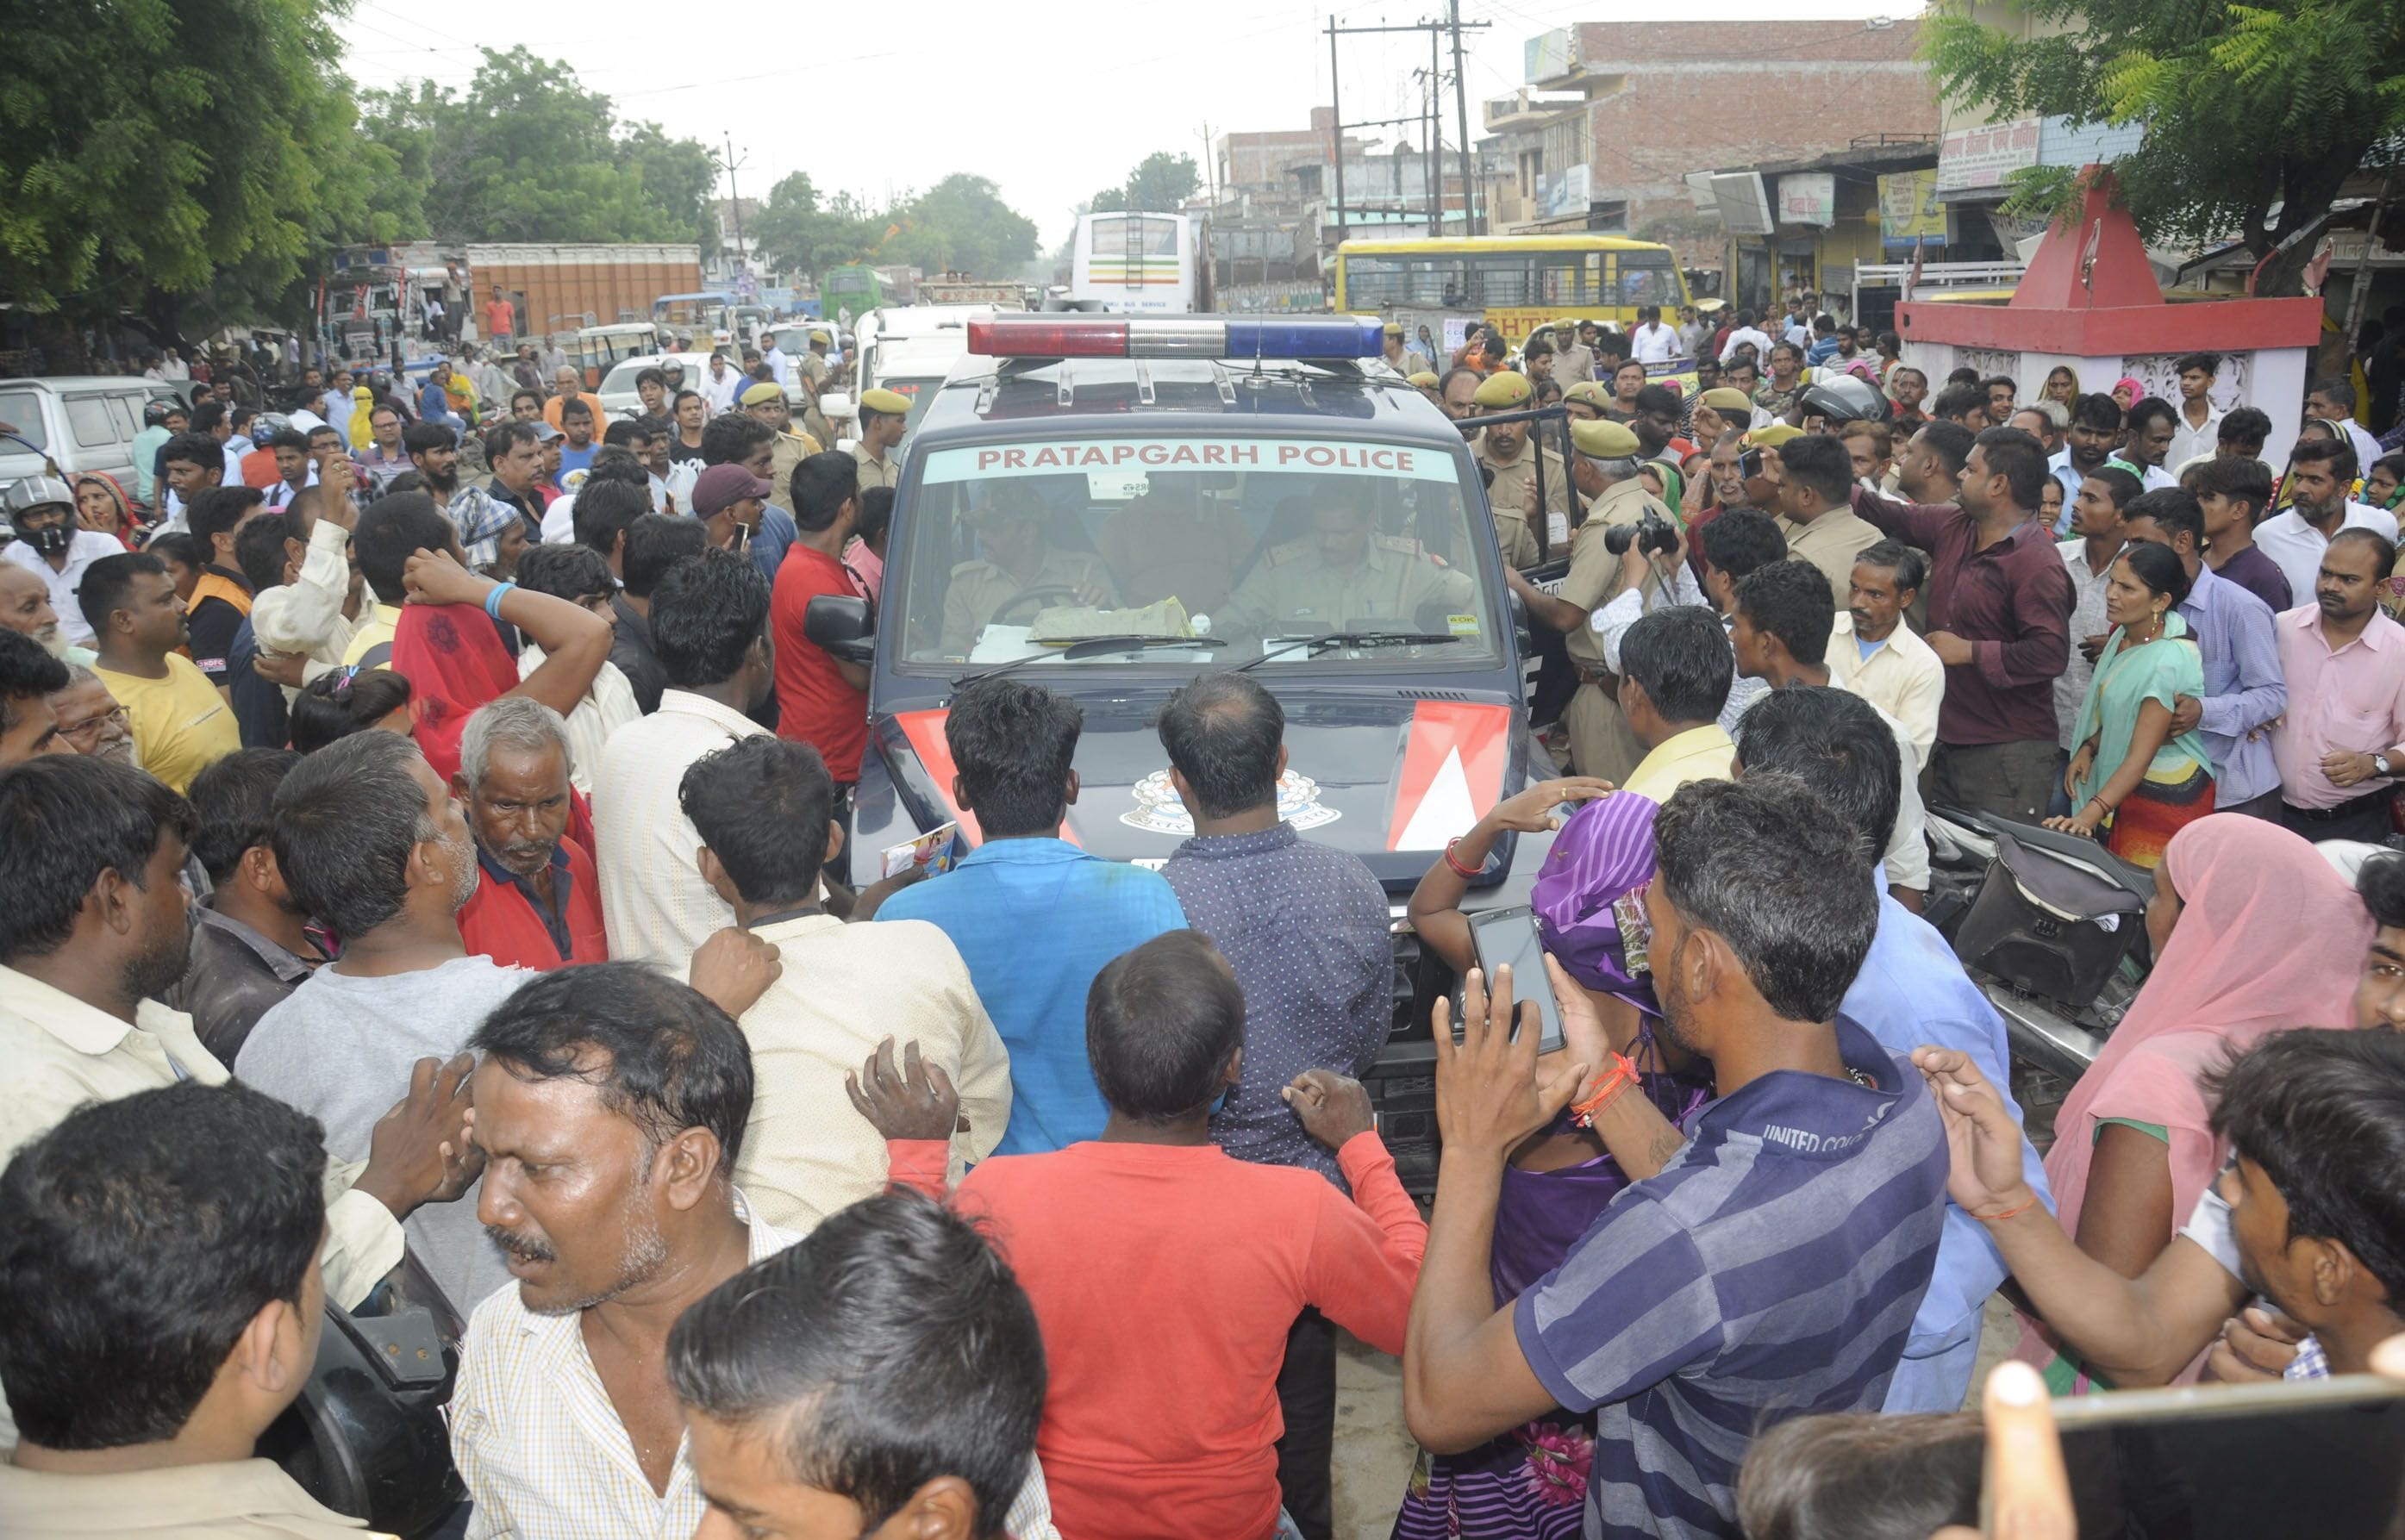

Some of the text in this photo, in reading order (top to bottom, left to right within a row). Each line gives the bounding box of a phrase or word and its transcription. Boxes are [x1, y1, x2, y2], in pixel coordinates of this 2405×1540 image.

[978, 444, 1415, 471] PRATAPGARH POLICE
[1763, 1124, 1820, 1152] UNITED
